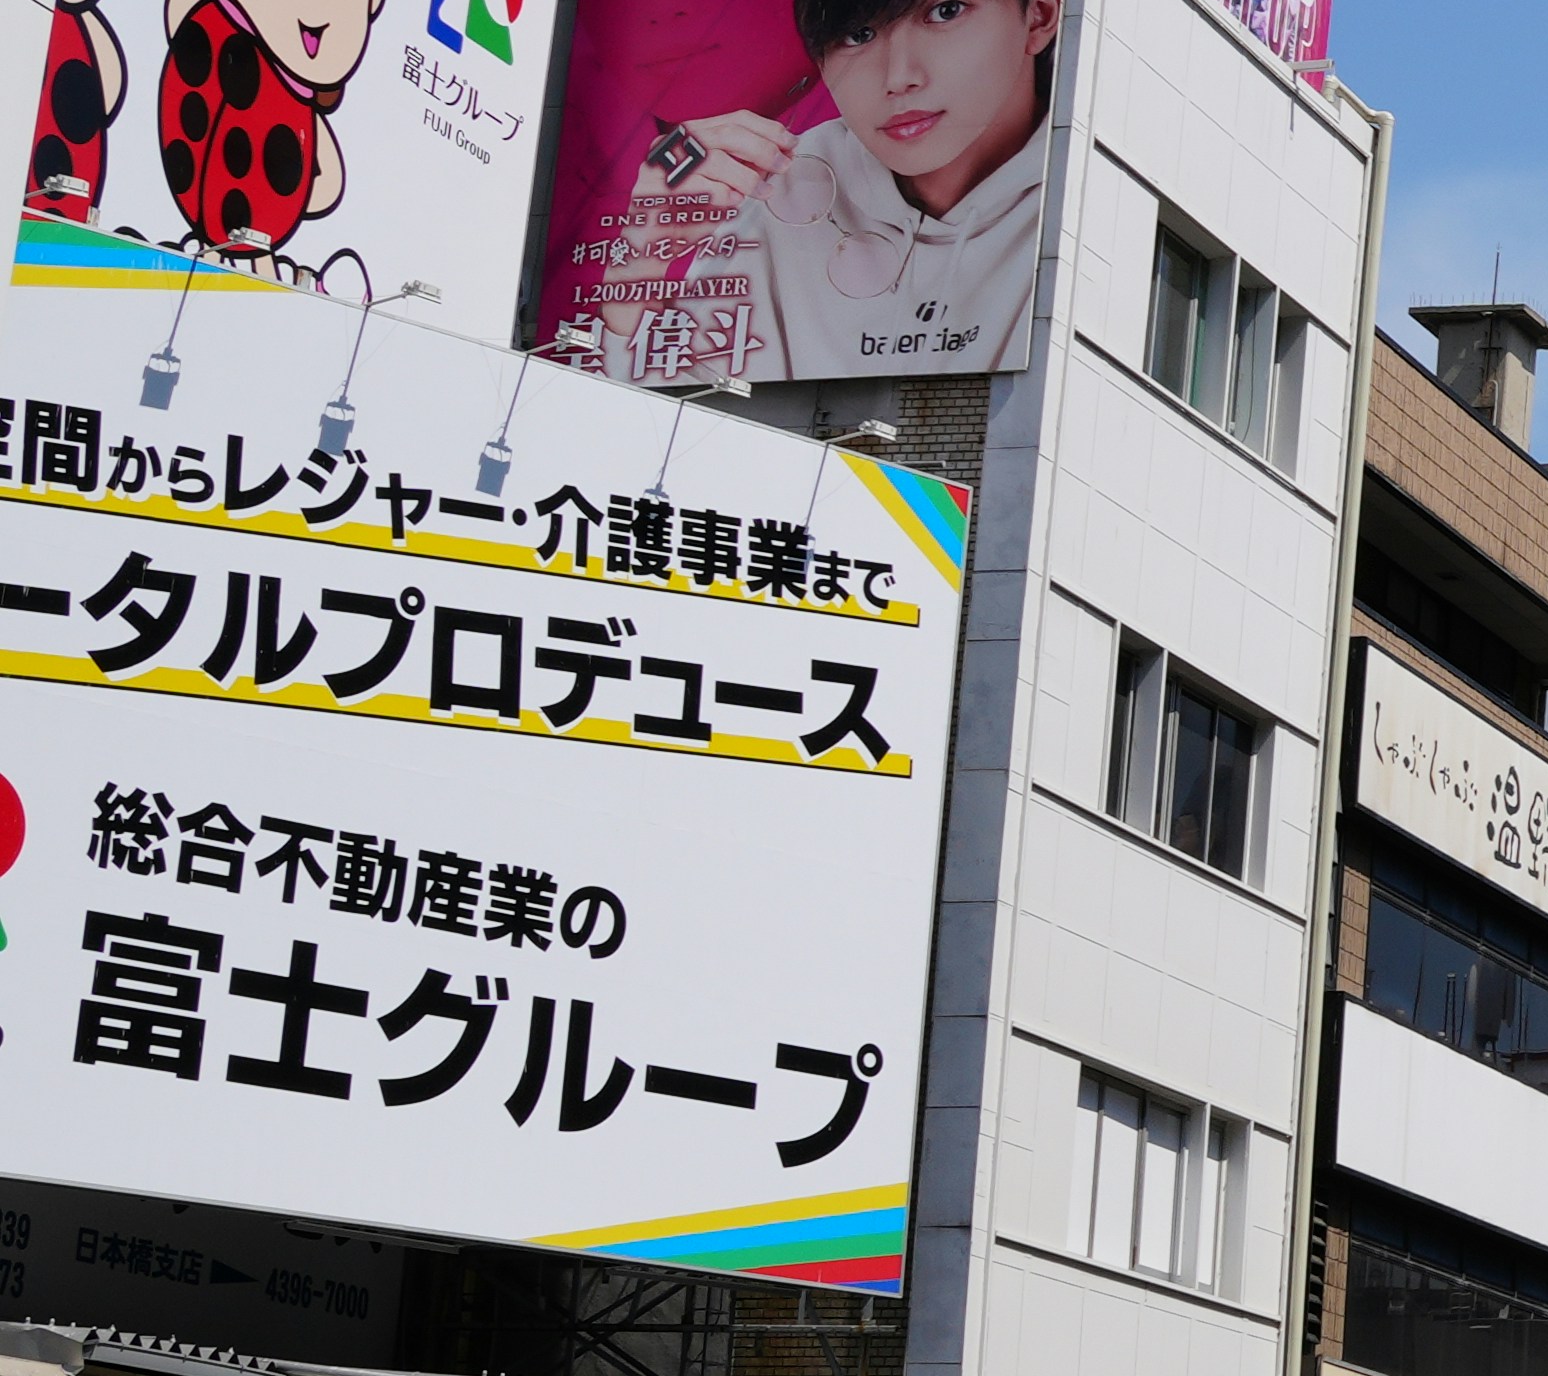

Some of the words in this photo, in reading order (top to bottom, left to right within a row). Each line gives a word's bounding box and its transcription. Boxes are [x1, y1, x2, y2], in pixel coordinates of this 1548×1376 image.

[402, 45, 525, 142] 富士グループ
[423, 109, 453, 141] FUJI
[455, 132, 492, 165] Group
[600, 215, 647, 227] ONE
[659, 209, 739, 224] GROUP
[572, 238, 759, 266] #可愛いモンスター
[573, 276, 748, 304] 1,200万円PLAYER
[629, 304, 764, 381] 偉斗
[0, 398, 893, 612] 間からレジャー・介護事業まで
[1373, 700, 1478, 812] しゃぶしゃぶ
[88, 782, 627, 959] 総合不動産業の
[73, 909, 884, 1169] 富士グループ
[75, 1228, 204, 1286] 日本橋支店
[265, 1267, 370, 1321] 4396-7000
